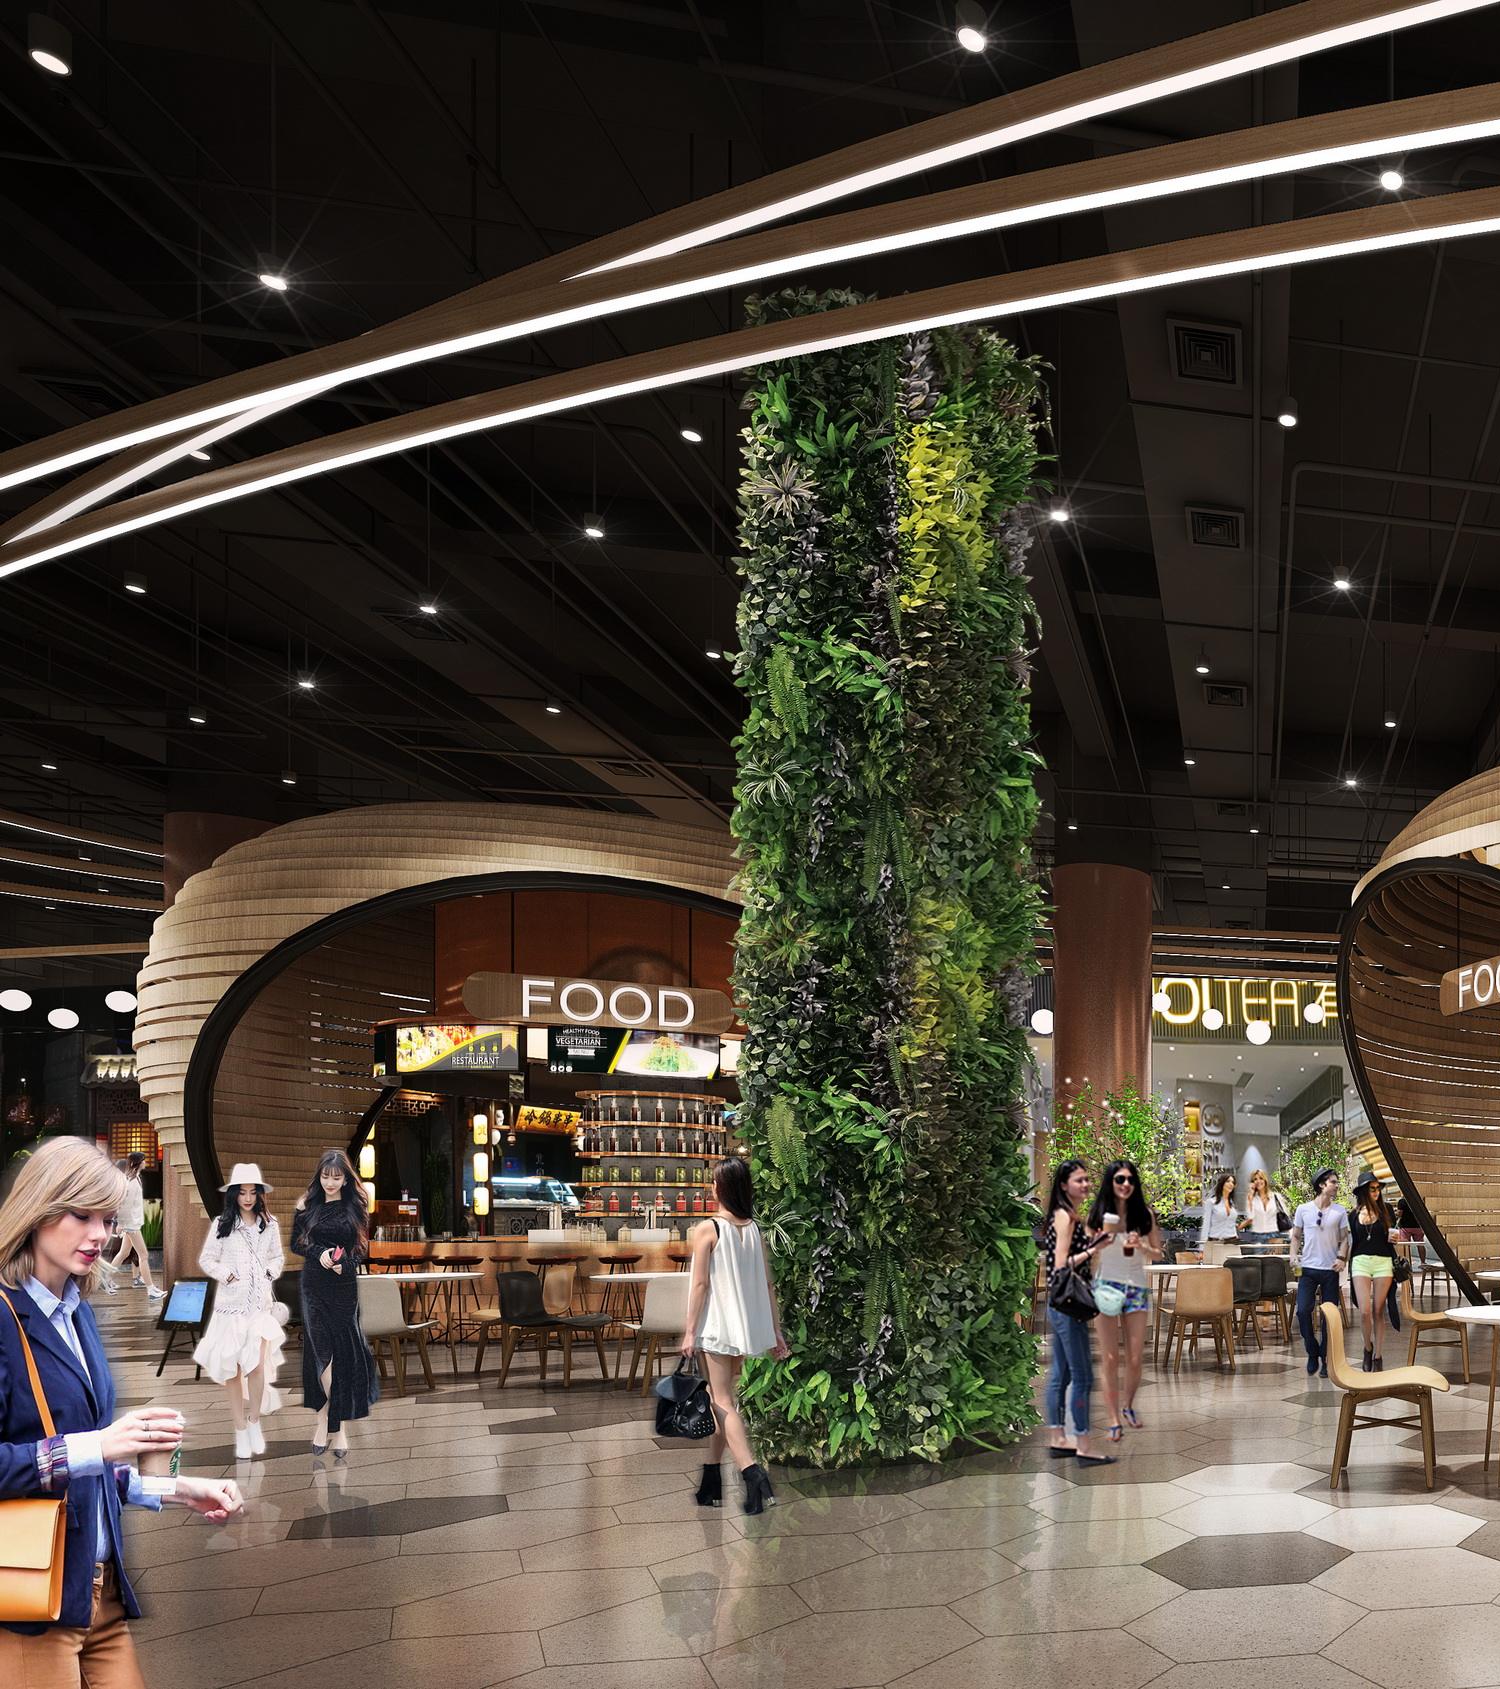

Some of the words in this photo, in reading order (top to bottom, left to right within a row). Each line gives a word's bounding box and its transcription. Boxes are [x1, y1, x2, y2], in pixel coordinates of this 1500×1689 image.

[522, 979, 695, 1027] FOOD
[585, 1028, 600, 1036] FOOD
[555, 1037, 601, 1046] VEGETARIAN
[451, 1056, 500, 1065] RESTAURANT
